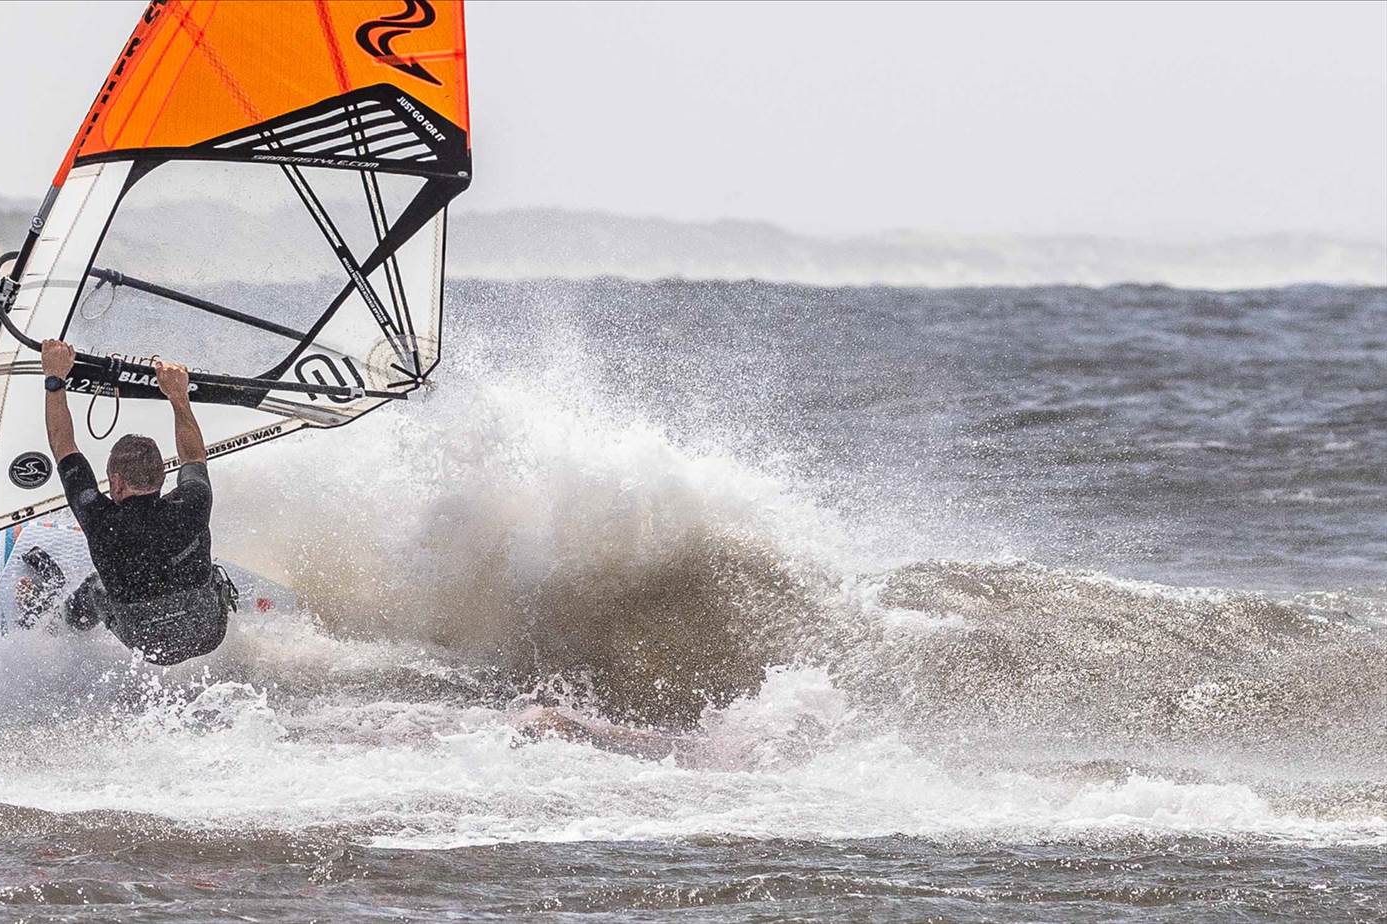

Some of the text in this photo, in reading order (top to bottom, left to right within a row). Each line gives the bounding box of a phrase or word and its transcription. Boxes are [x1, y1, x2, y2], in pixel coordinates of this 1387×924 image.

[397, 96, 446, 142] JUST GO FOR IT
[118, 371, 198, 393] BLACP
[252, 425, 282, 441] WAVE
